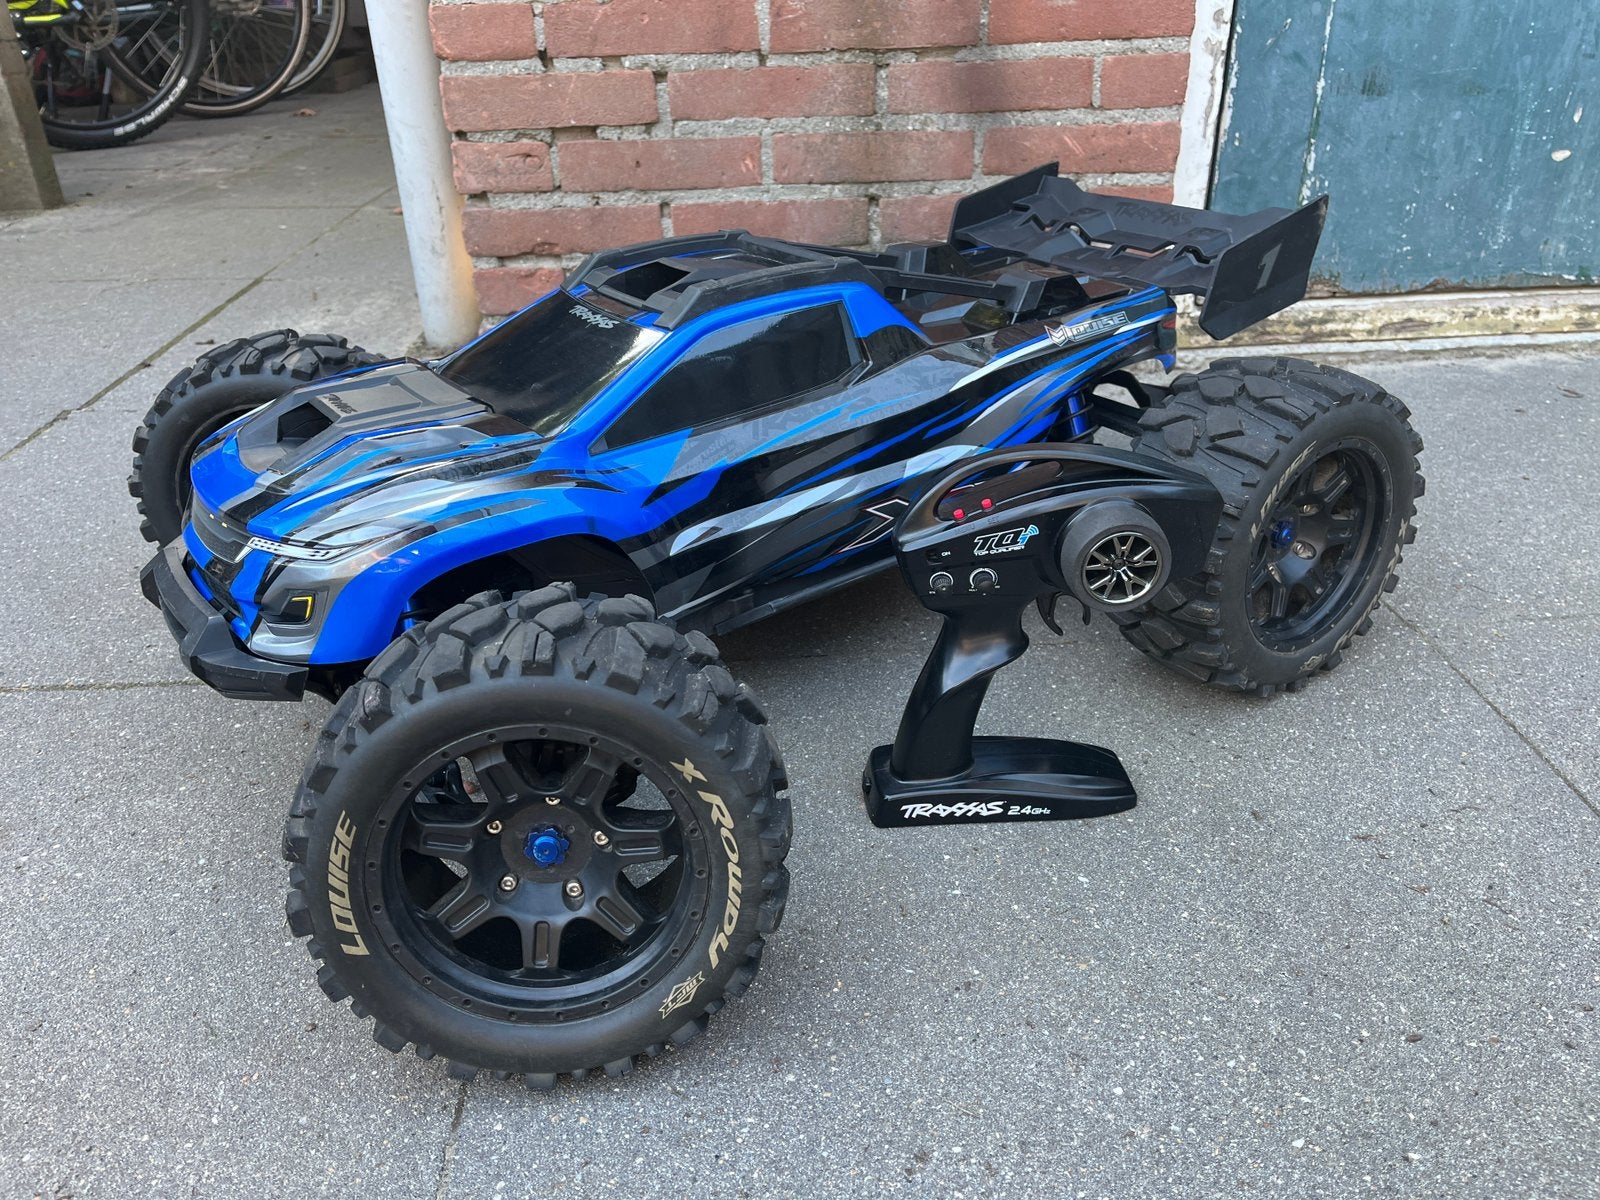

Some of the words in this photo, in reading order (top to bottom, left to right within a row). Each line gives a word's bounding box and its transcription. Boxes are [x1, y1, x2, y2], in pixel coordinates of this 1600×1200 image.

[1114, 201, 1198, 225] TRAXXAS
[1256, 243, 1282, 290] 1
[569, 304, 620, 329] TRAXXAS
[900, 801, 1007, 819] TRAXXAS
[1007, 805, 1052, 816] 2.4GHz
[669, 758, 709, 784] X
[697, 789, 741, 969] ROWDY
[327, 809, 370, 957] LOUISE
